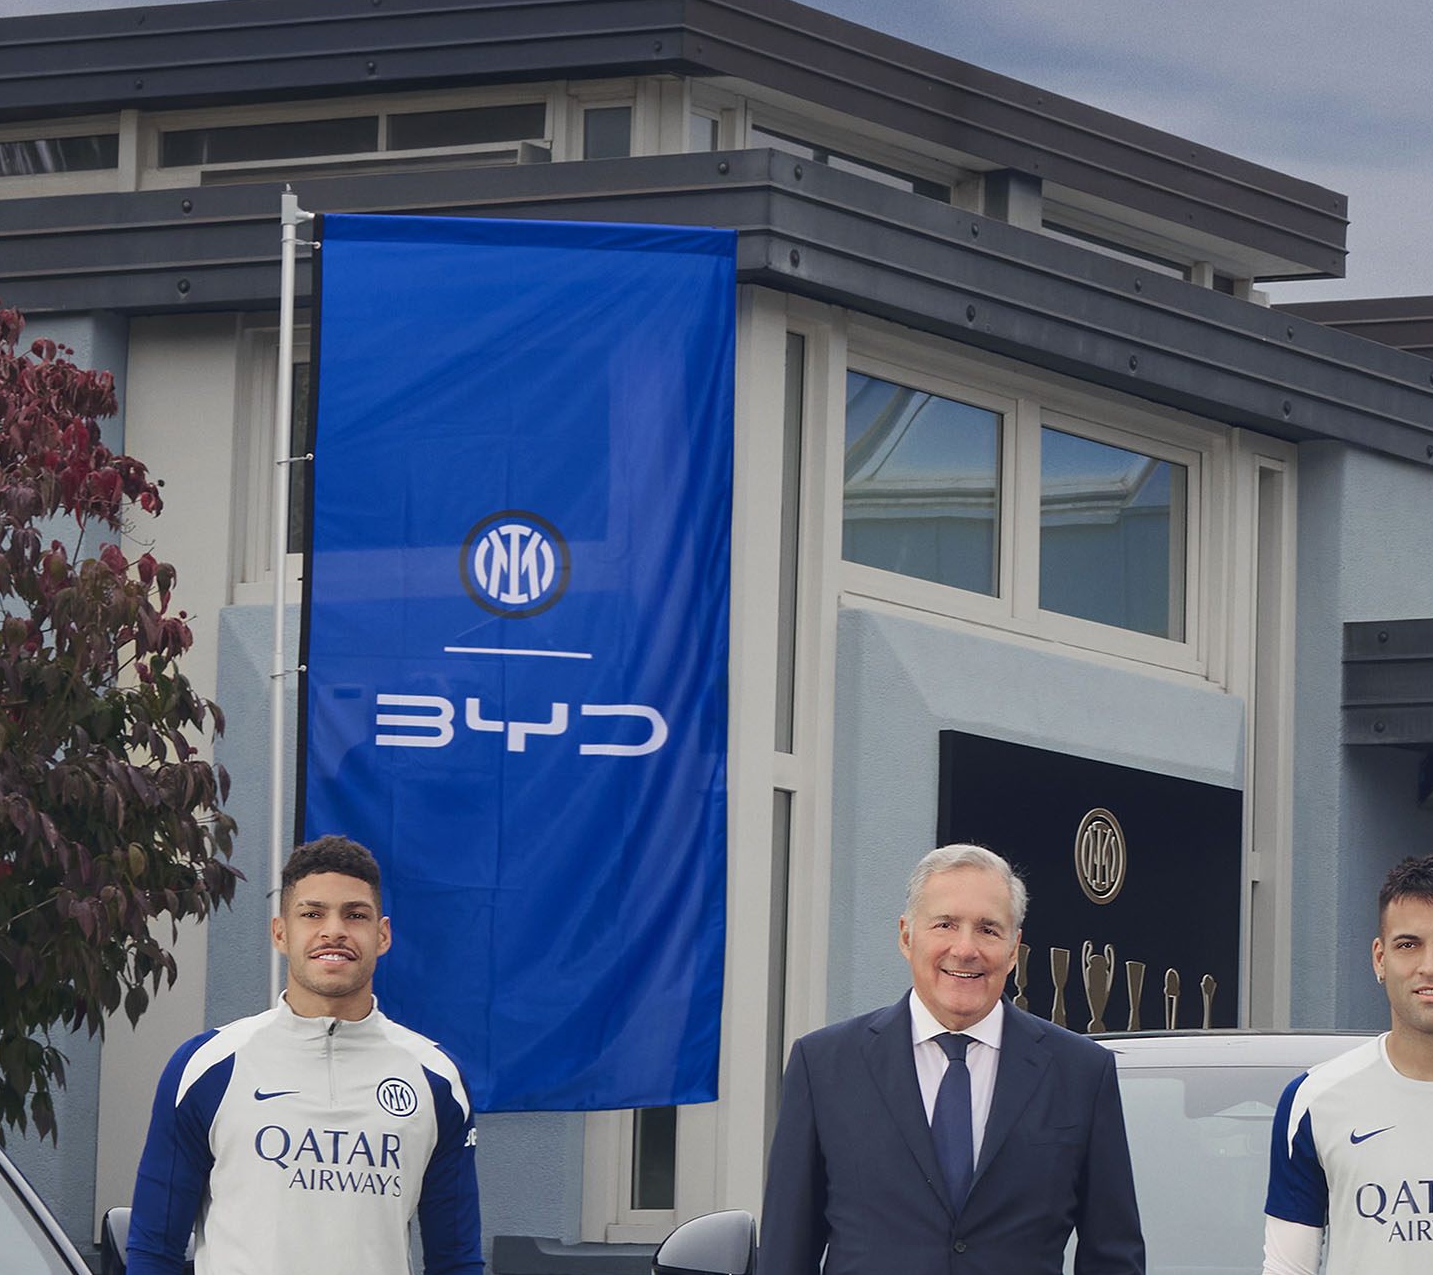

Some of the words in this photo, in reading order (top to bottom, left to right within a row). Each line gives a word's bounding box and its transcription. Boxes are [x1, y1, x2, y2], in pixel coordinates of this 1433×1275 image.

[376, 694, 669, 756] BYD
[256, 1125, 401, 1170] QATAR
[289, 1169, 402, 1197] AIRWAYS
